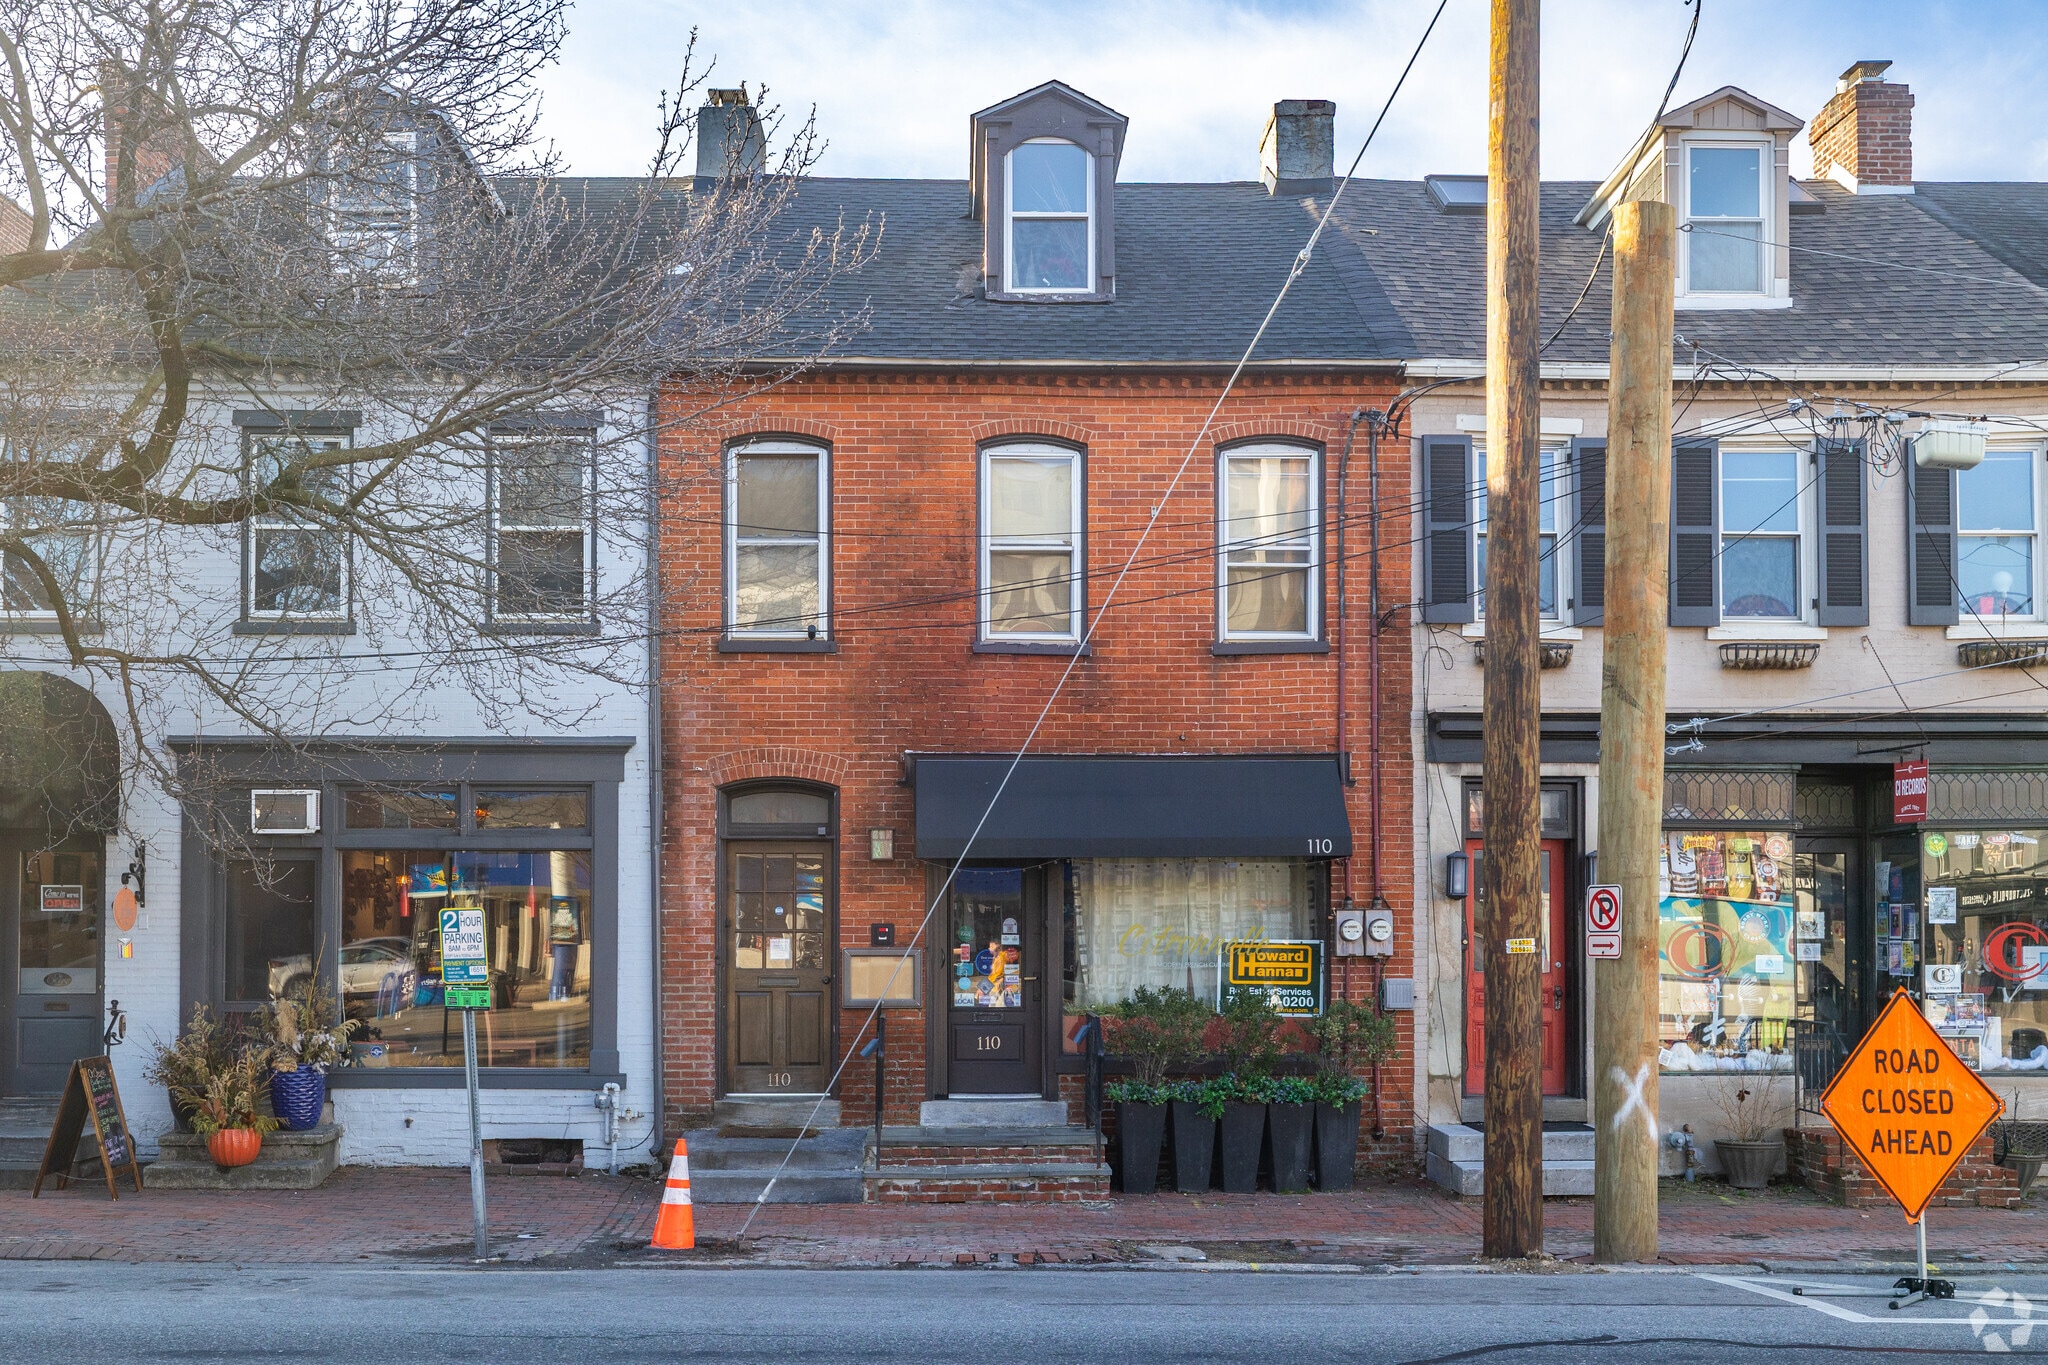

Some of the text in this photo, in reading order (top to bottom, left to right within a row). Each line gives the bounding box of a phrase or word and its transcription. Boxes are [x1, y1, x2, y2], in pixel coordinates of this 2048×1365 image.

[1901, 777, 1927, 796] RECORDS
[1307, 838, 1333, 854] 110
[44, 888, 59, 899] Come
[44, 899, 79, 908] OPEN
[442, 911, 482, 932] 2 HOUR
[1740, 912, 1754, 929] SORRY
[444, 933, 483, 944] PARKING
[1119, 924, 1270, 957] Citronnelle
[1743, 932, 1766, 941] CLOSED
[1238, 951, 1304, 963] Howard
[1249, 987, 1275, 995] Este
[1276, 987, 1312, 995] Services
[976, 1036, 1001, 1051] 110
[1950, 1039, 1976, 1053] NTA
[1874, 1049, 1940, 1074] ROAD
[767, 1072, 791, 1087] 110
[1861, 1088, 1954, 1115] CLOSED
[1871, 1129, 1953, 1156] AHEAD
